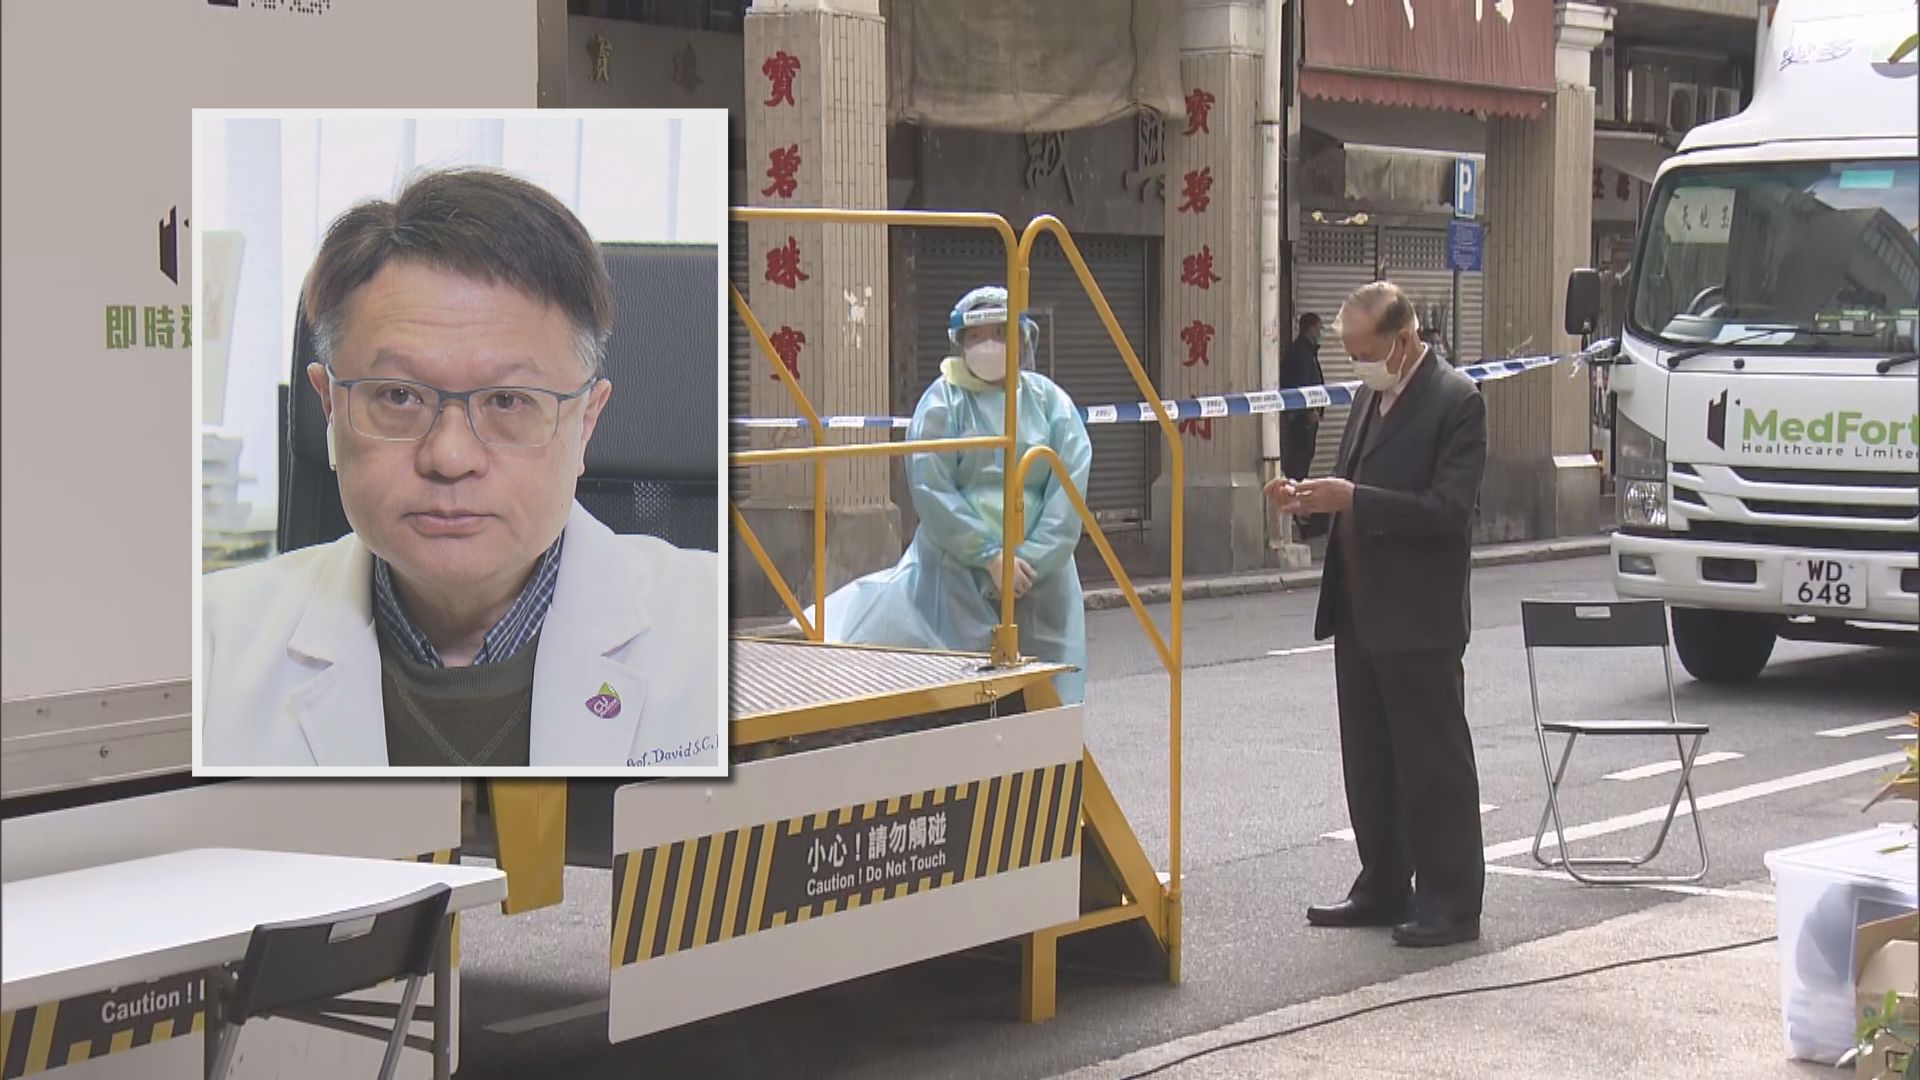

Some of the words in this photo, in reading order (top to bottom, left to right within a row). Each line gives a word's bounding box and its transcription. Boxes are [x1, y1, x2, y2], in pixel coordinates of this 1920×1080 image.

[1458, 162, 1473, 210] P
[1741, 443, 1844, 456] Healthcare
[1855, 446, 1918, 459] Limite
[1808, 560, 1842, 581] WD
[1798, 582, 1851, 605] 648
[652, 742, 691, 763] David
[807, 872, 855, 896] Caution
[866, 866, 882, 882] Do
[886, 860, 906, 878] Not
[910, 850, 946, 871] Touch
[101, 990, 180, 1023] Caution
